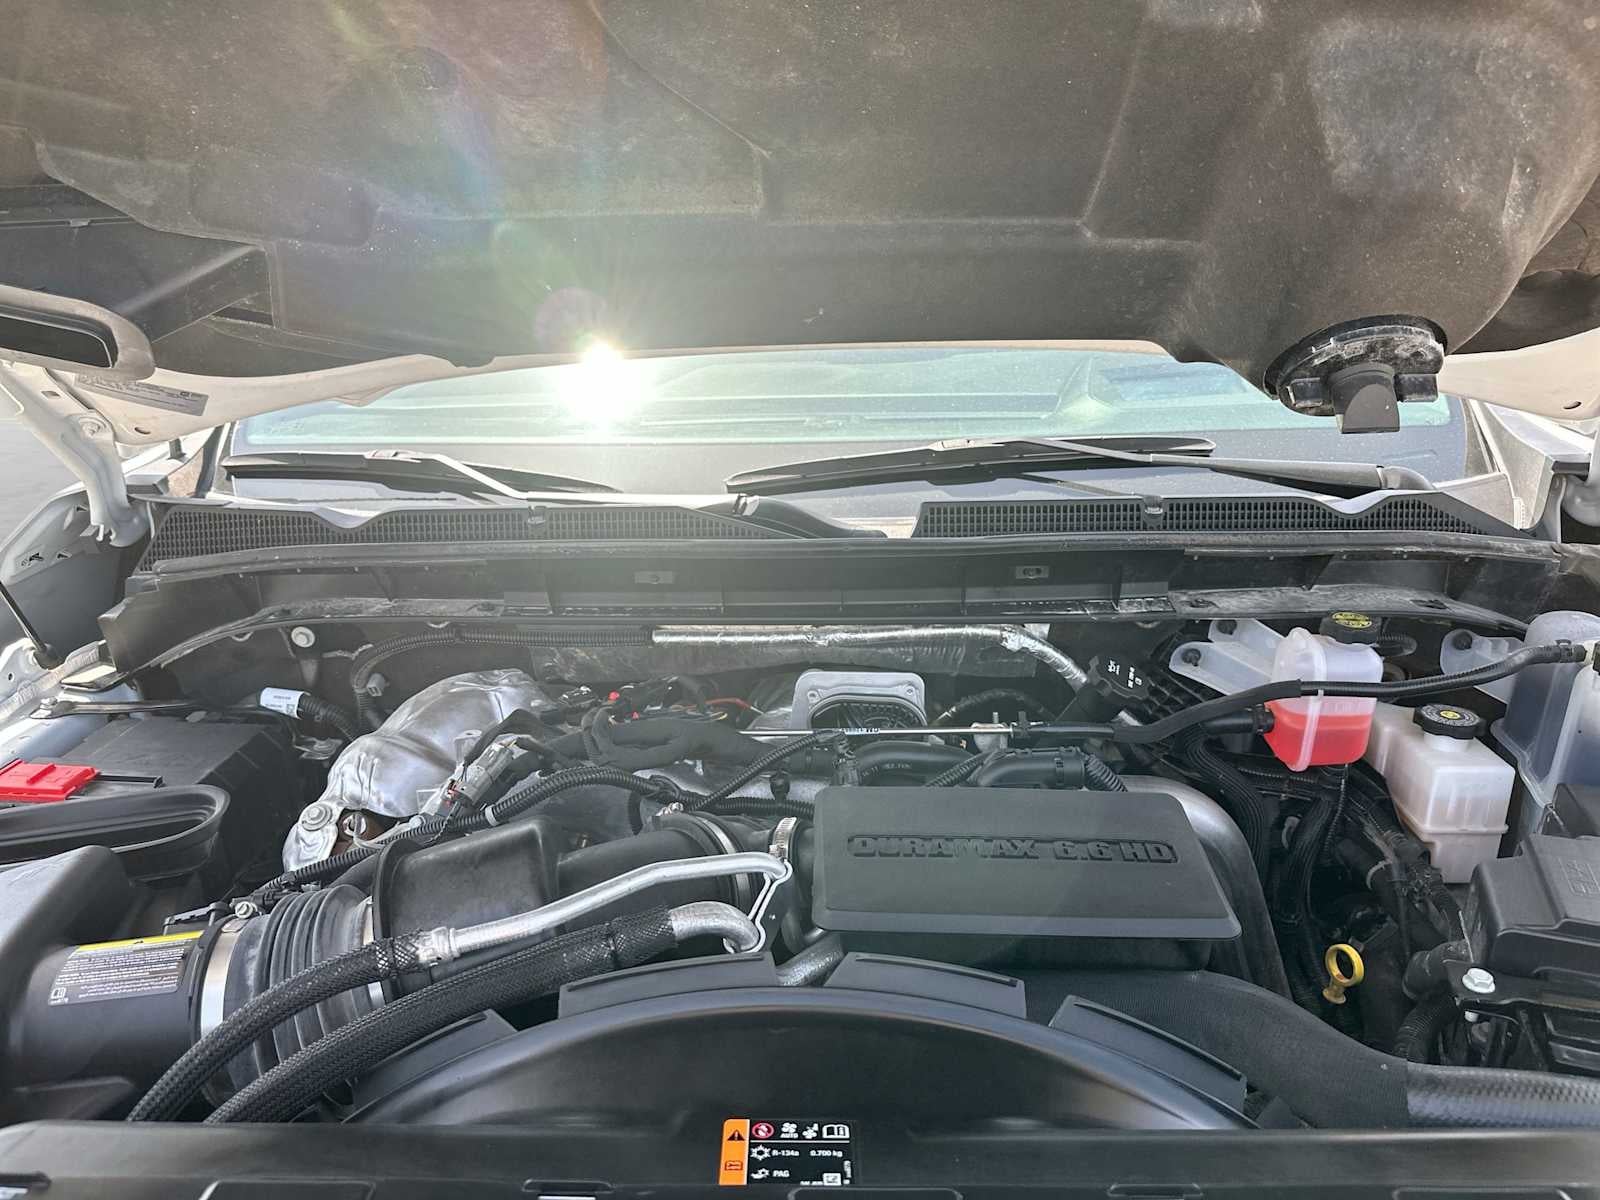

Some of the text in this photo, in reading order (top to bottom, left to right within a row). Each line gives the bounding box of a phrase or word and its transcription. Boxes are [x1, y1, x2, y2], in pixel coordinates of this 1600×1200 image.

[851, 836, 1178, 864] DURAMAX 6.6 HD
[832, 1150, 843, 1158] kg
[772, 1169, 790, 1178] PAG
